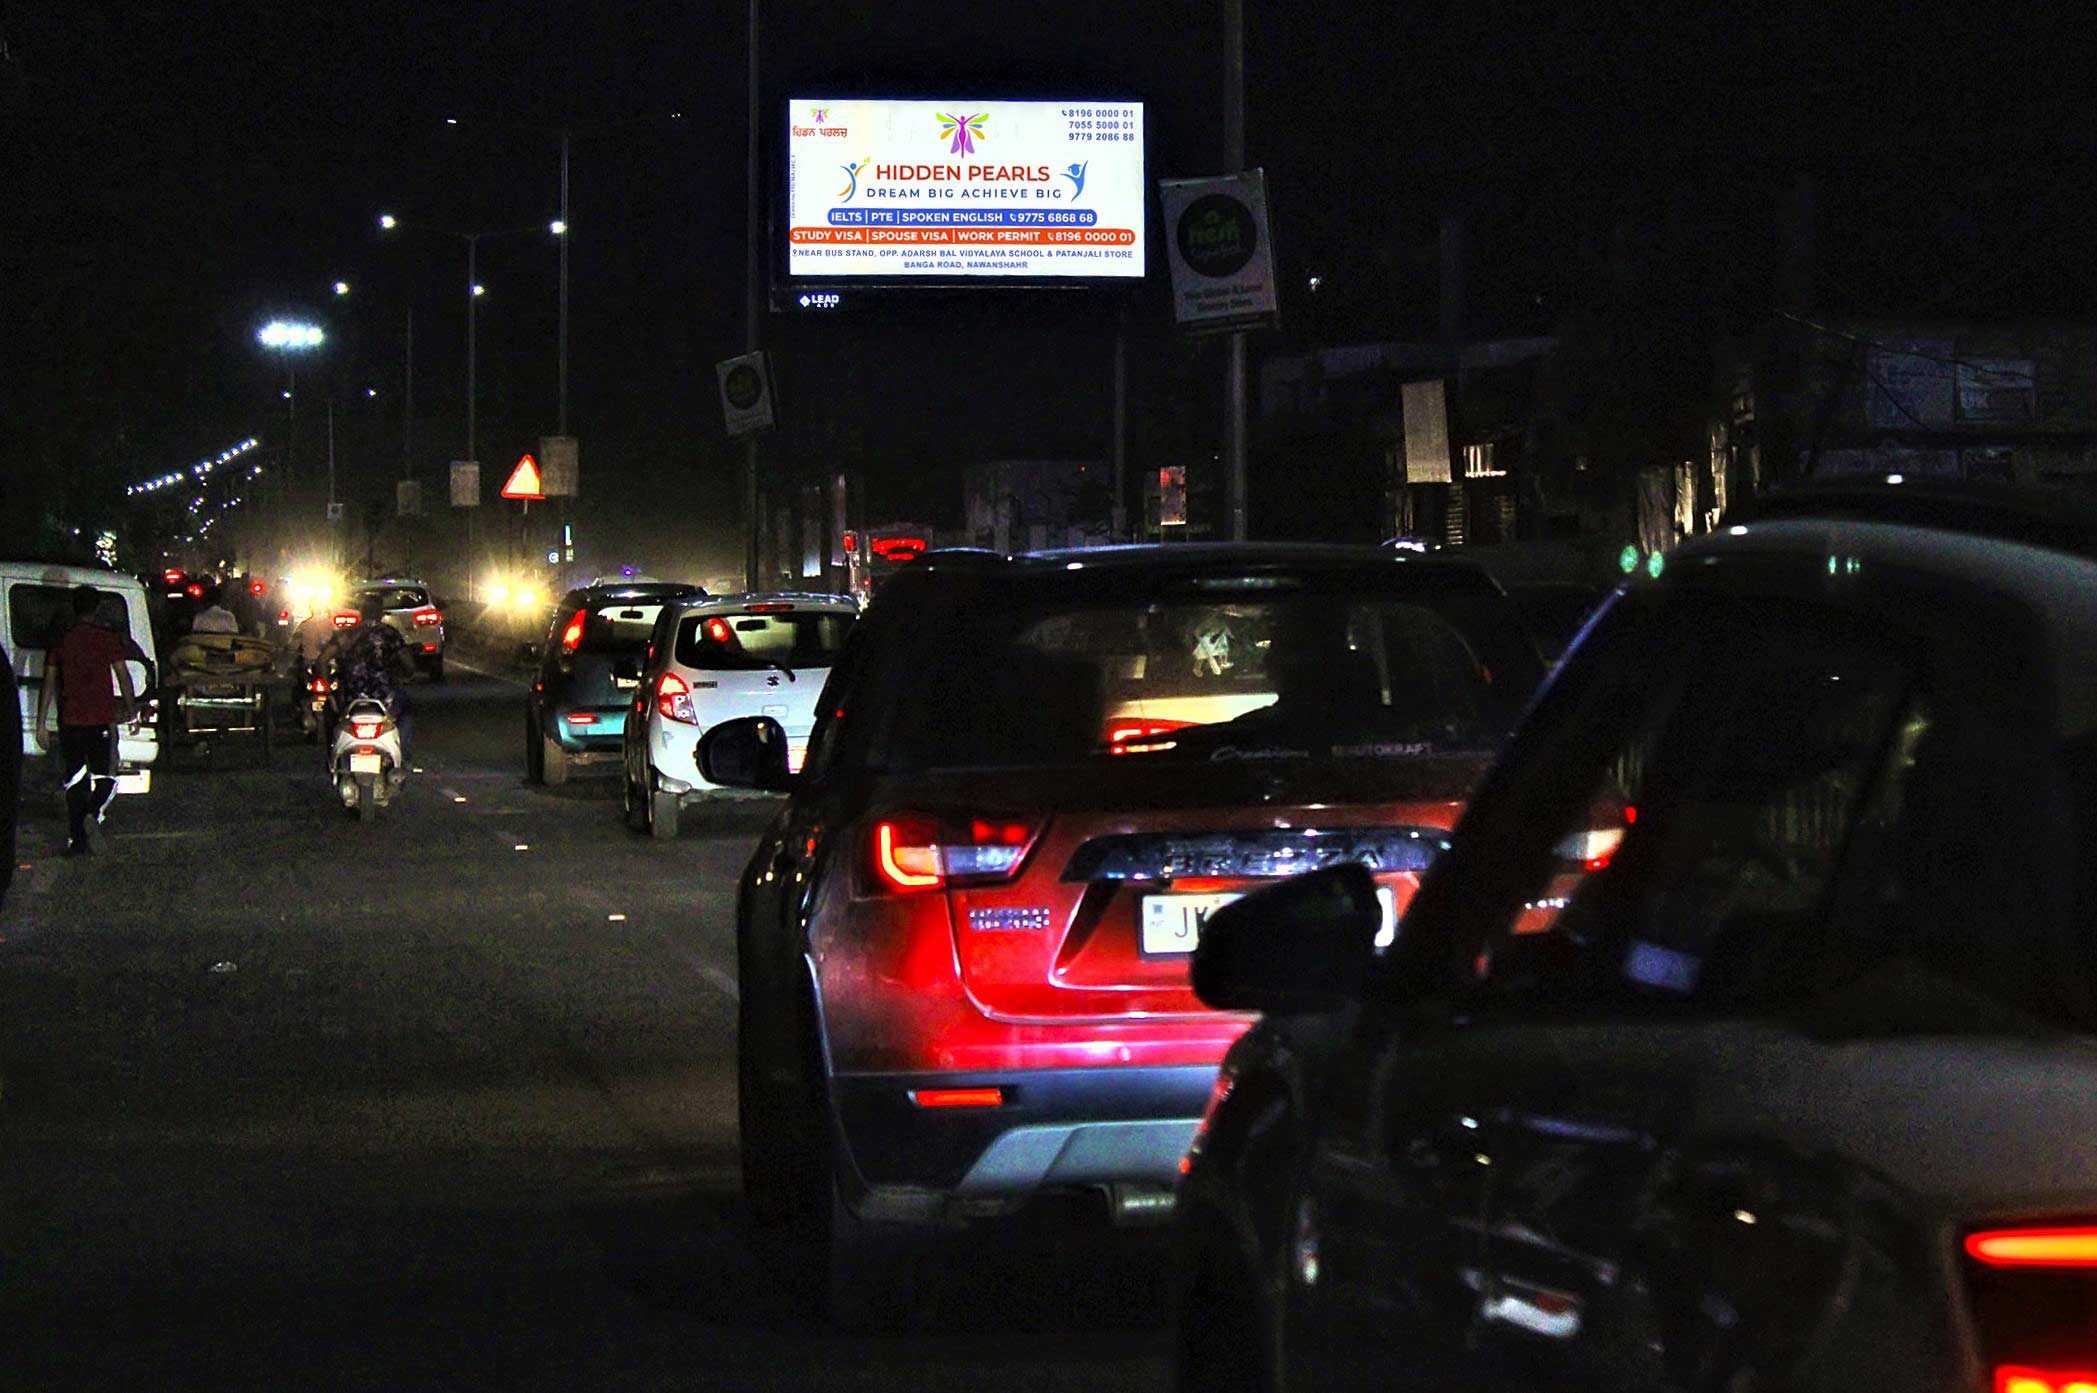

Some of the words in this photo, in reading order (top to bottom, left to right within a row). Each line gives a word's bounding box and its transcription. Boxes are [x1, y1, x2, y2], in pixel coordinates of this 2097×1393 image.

[1069, 121, 1093, 129] 7055
[1096, 121, 1119, 129] 5000
[1123, 121, 1134, 129] 01
[1069, 133, 1093, 141] 9779
[1096, 133, 1119, 141] 2086
[1123, 133, 1134, 141] 88
[876, 165, 961, 181] HIDDEN
[968, 165, 1050, 182] PEARLS
[867, 188, 920, 198] DREAM
[928, 188, 954, 198] BIG
[961, 189, 1028, 198] ACHIEVE
[1036, 189, 1062, 198] BIG
[831, 212, 862, 221] IELTS
[871, 212, 893, 221] PTE
[902, 212, 950, 222] SPOKEN
[953, 212, 1003, 222] ENGLISH
[1017, 213, 1045, 222] 9775
[1047, 213, 1076, 222] 6868
[1079, 213, 1094, 222] 68
[793, 231, 831, 241] STUDY
[835, 231, 863, 241] VISA
[871, 231, 918, 241] SPOUSE
[921, 231, 949, 241] VISA
[957, 231, 994, 241] WORK
[997, 232, 1041, 241] PERMIT
[1055, 232, 1081, 242] 8196
[1084, 233, 1117, 242] 0000
[1119, 233, 1132, 242] 01
[845, 250, 877, 258] STAND,
[937, 261, 965, 269] ROAD,
[811, 294, 840, 304] LEAD
